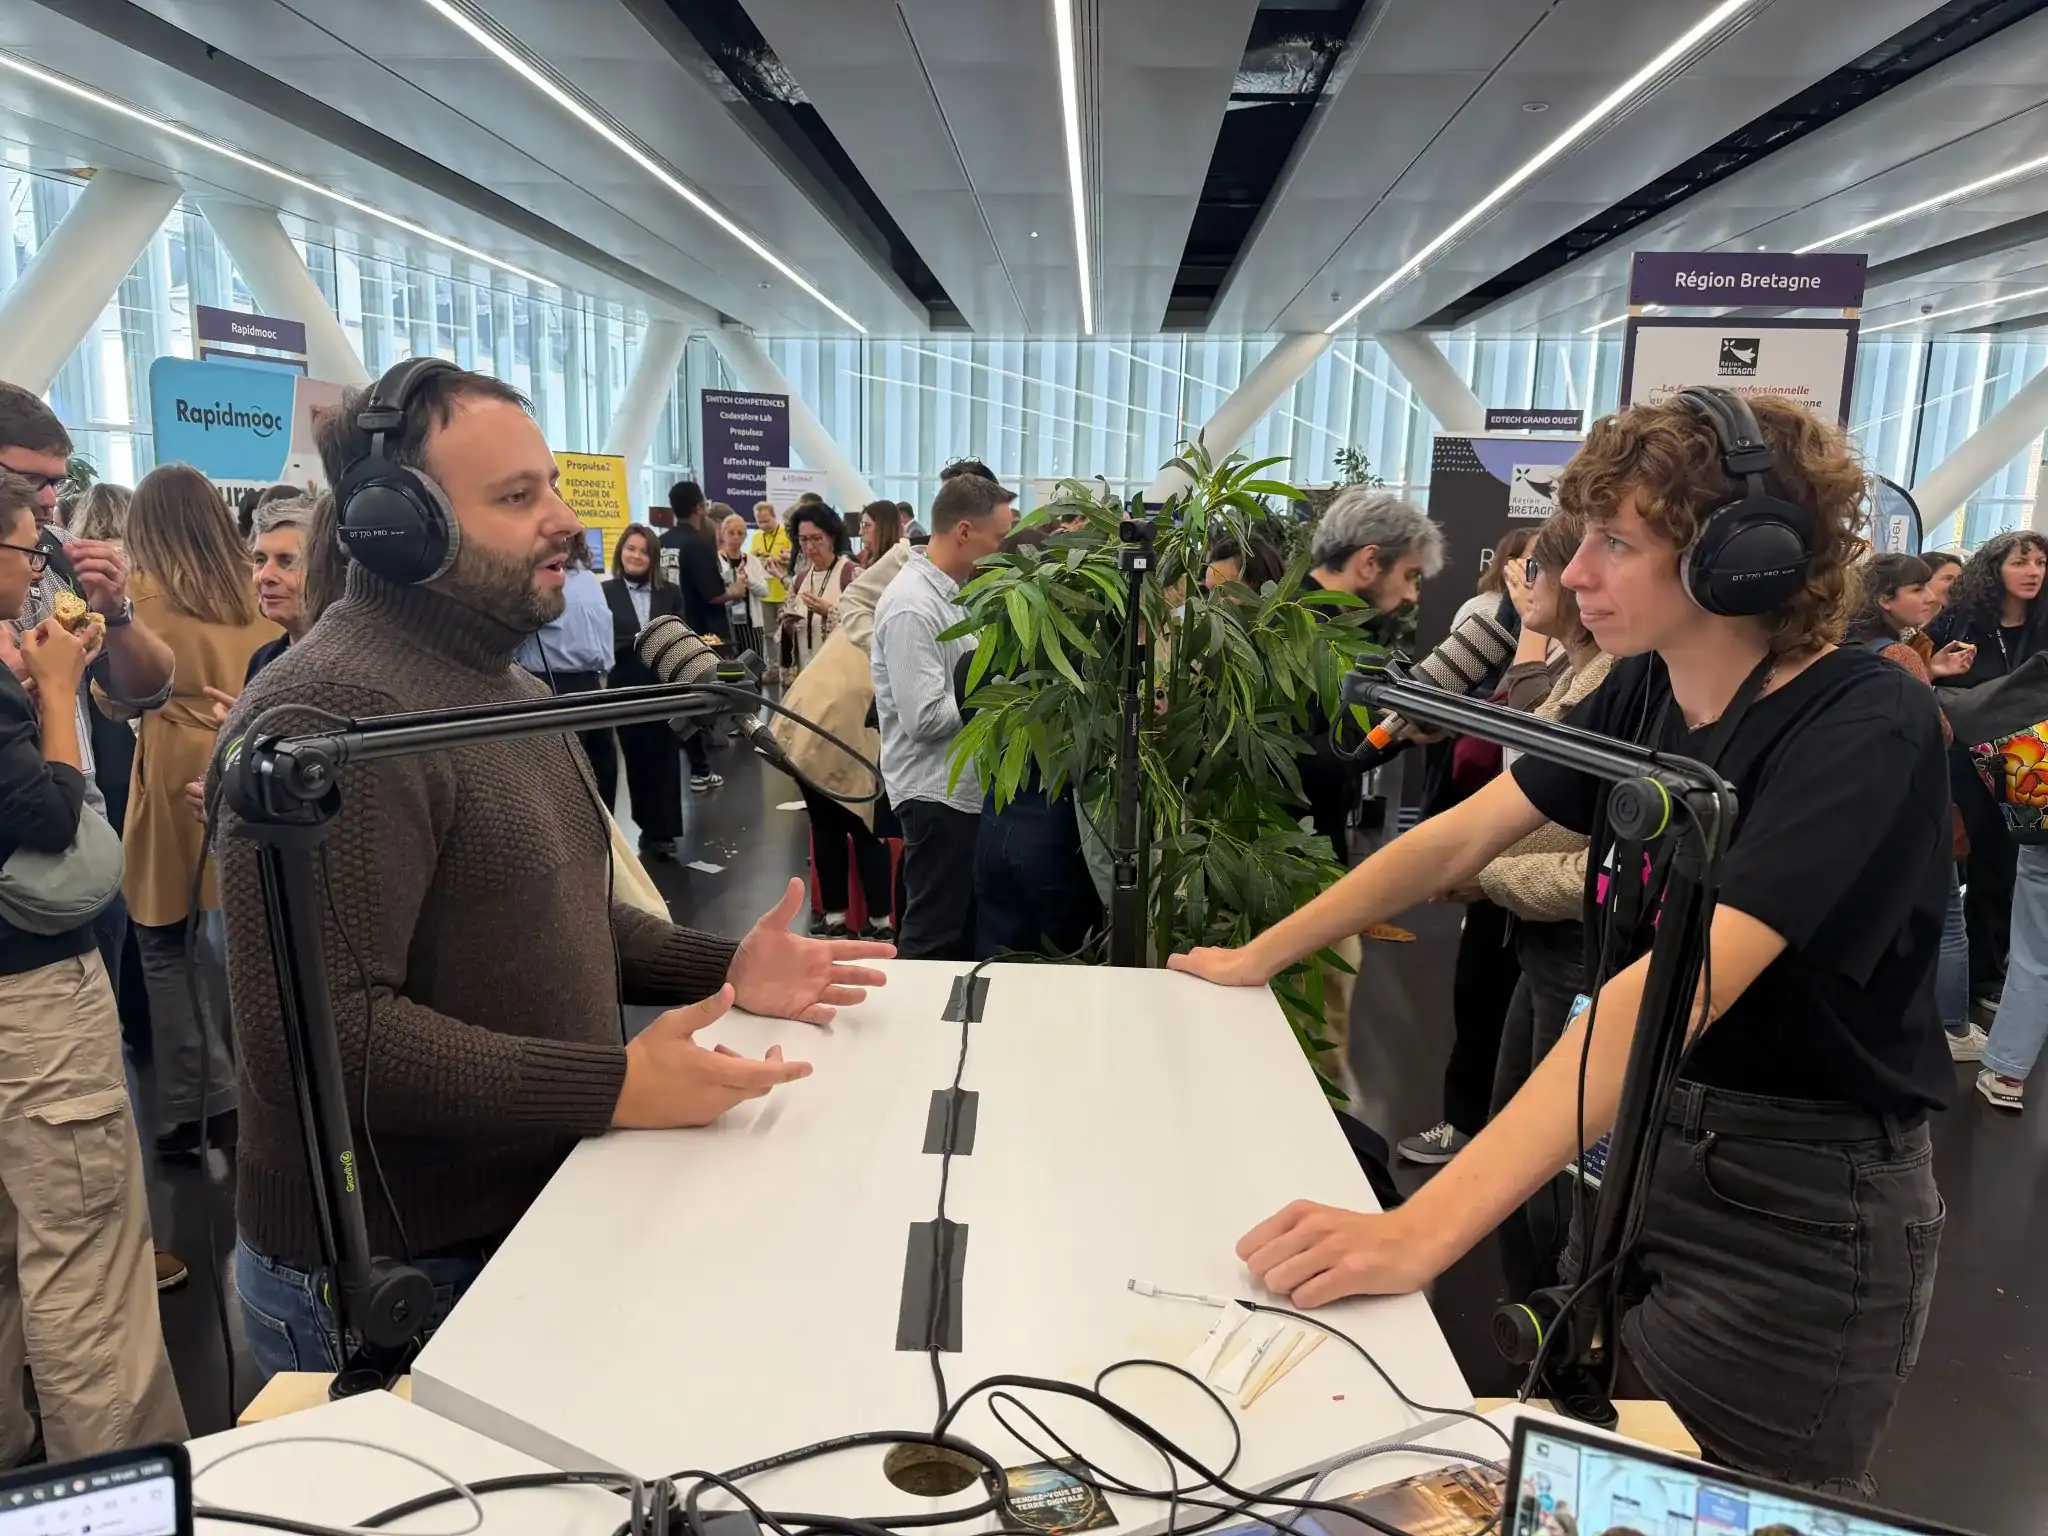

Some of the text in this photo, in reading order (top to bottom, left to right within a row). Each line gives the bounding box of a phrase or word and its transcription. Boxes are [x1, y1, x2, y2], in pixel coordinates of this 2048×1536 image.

[1675, 270, 1821, 291] Région Bretagne
[231, 322, 278, 340] Rapidmooc
[1720, 360, 1742, 368] Région
[1718, 367, 1757, 375] BRETAGNE
[1737, 384, 1810, 396] rofessionnelle
[705, 394, 786, 408] SWITCH COMPETENCES
[175, 398, 283, 434] Rapidmooc
[760, 413, 773, 422] Lab
[1490, 415, 1579, 425] EDTECH GRAND OUEST
[734, 443, 760, 452] Edunao
[723, 457, 771, 467] EdTech France
[1508, 505, 1554, 516] BRETAGN
[373, 529, 388, 537] PRO
[1010, 1486, 1084, 1505] RENDEZ-VOUS EN
[1015, 1494, 1085, 1511] TERRE DIGITALE
